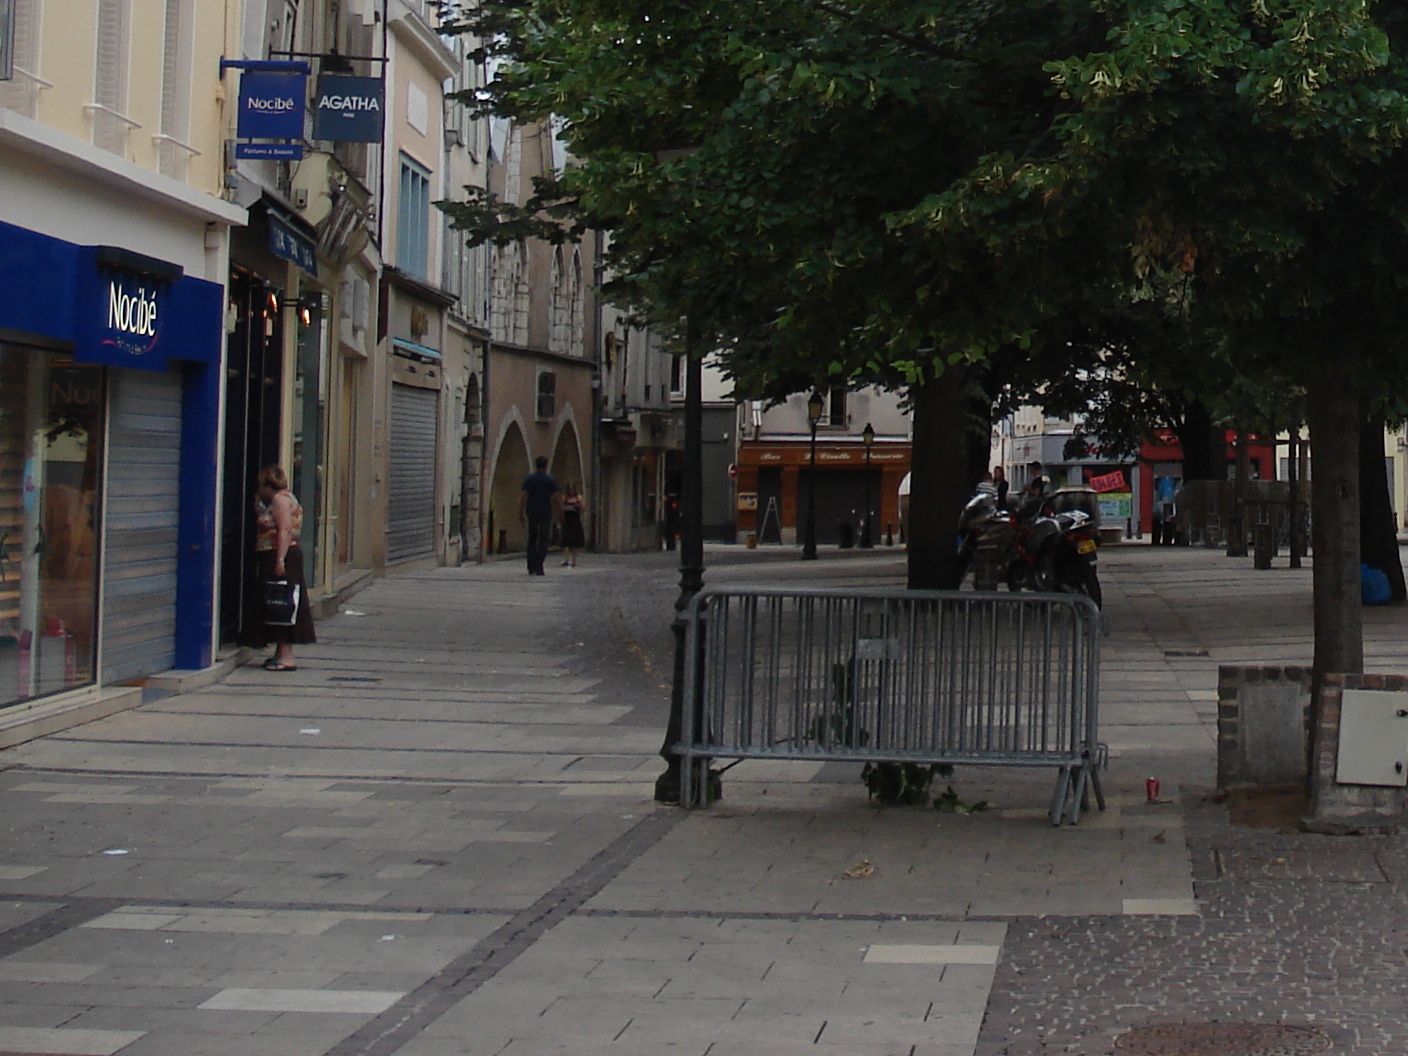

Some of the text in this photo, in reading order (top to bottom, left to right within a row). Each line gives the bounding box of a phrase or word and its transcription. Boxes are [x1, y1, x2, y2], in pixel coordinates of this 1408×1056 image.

[248, 96, 294, 110] Nocibé
[319, 95, 380, 112] AGATHA
[107, 280, 158, 337] Nocibé
[1091, 472, 1125, 491] SOLDES
